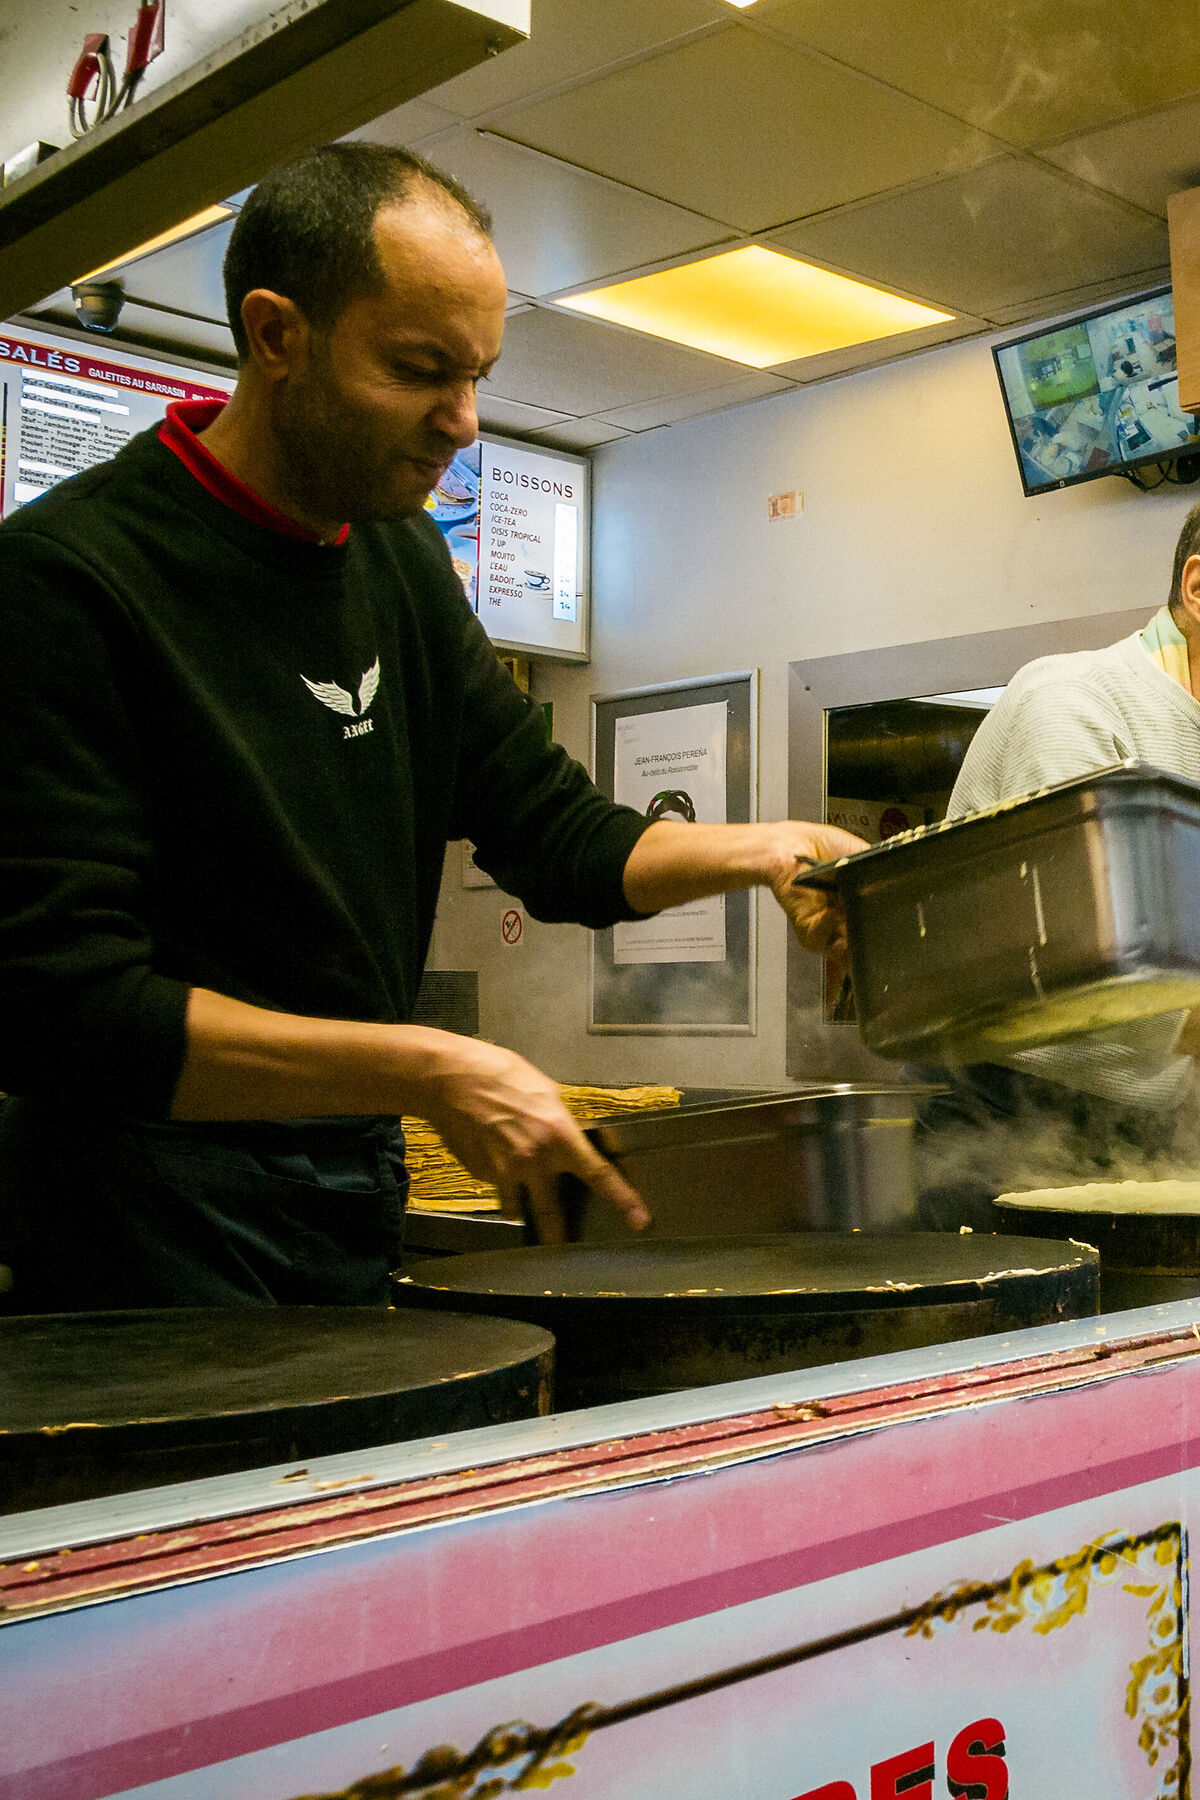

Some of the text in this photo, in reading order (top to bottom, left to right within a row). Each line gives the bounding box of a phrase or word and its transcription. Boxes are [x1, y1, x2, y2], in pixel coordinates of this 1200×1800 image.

[88, 367, 131, 386] GALETTES
[132, 377, 144, 388] AU
[145, 380, 186, 399] SARRASIN
[492, 467, 573, 498] BOISSONS
[490, 490, 509, 501] COCA
[489, 502, 528, 517] COCA-ZERO
[491, 514, 516, 526] ICE-TEA
[510, 530, 542, 543] TROPICAL
[490, 550, 516, 562] MOJITO
[489, 573, 515, 585] BADOIT
[488, 585, 523, 599] EXPRESSO
